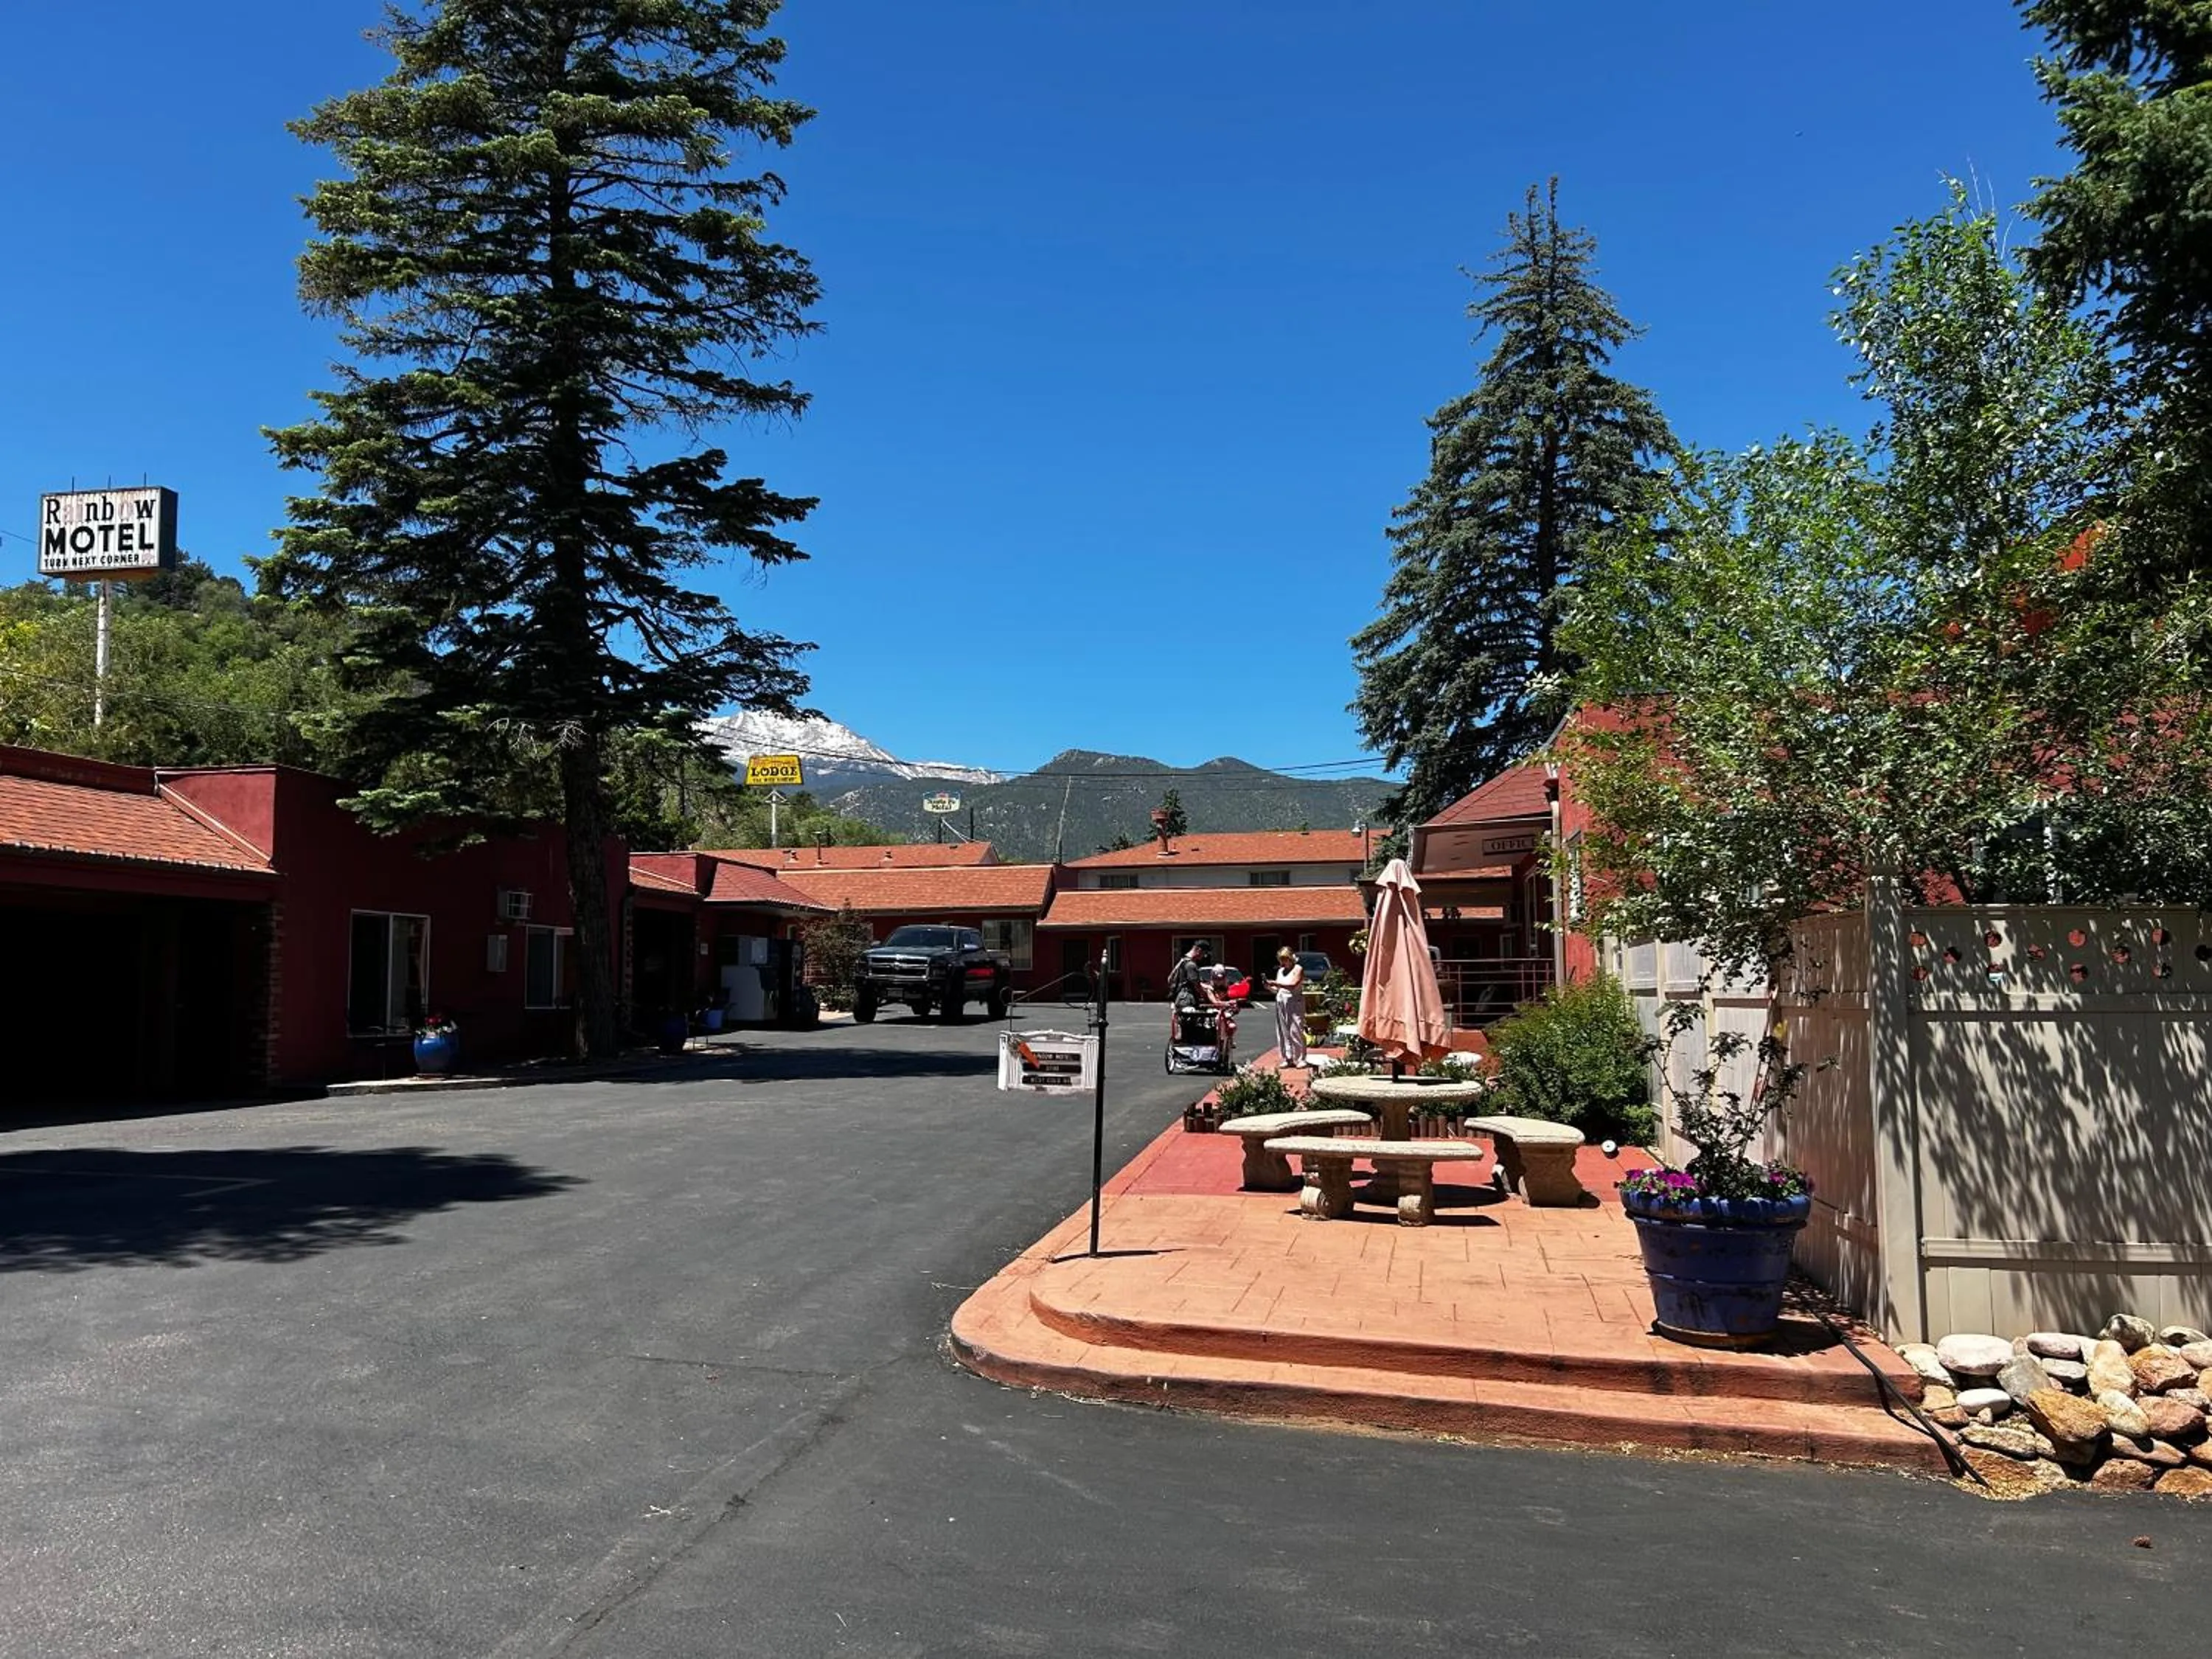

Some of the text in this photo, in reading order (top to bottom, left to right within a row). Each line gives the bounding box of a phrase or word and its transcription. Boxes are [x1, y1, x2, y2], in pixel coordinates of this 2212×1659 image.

[45, 523, 154, 555] MOTEL
[72, 556, 96, 566] NEXT
[100, 554, 139, 565] CORNER
[751, 767, 798, 776] LODGE
